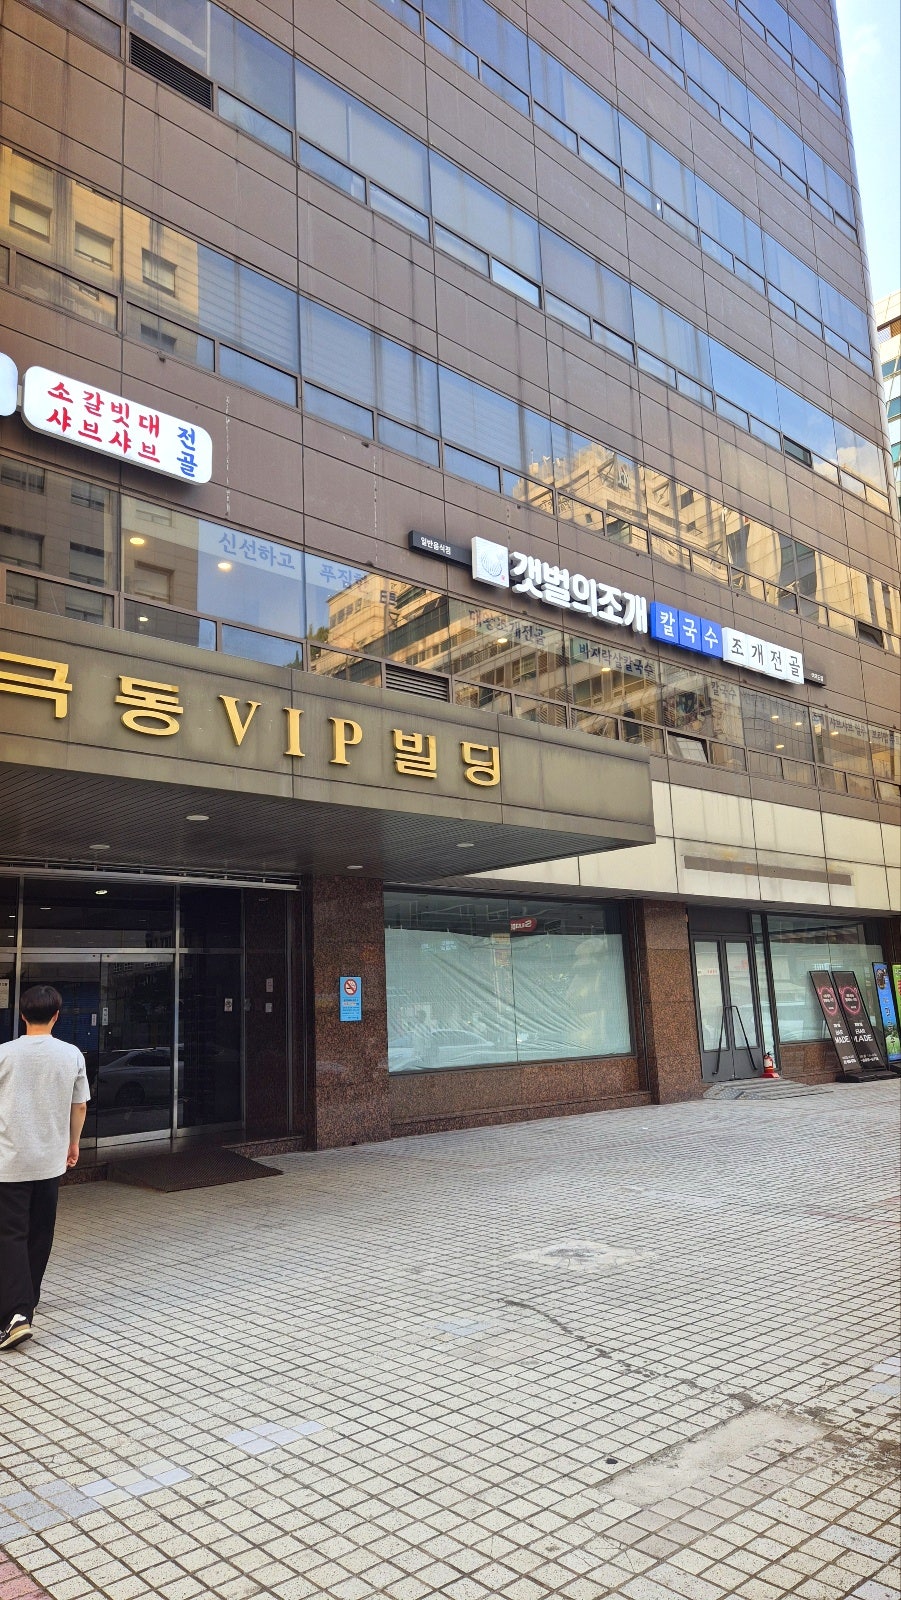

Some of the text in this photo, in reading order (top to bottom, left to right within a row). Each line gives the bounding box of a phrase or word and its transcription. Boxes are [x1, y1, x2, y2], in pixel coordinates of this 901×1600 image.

[48, 381, 160, 438] 소갈빗대
[46, 406, 161, 464] 샤브샤브
[176, 426, 199, 478] 전골
[218, 531, 296, 570] 신선하고
[420, 536, 452, 556] 일반음식점
[509, 551, 649, 634] 갯벌의조개
[659, 610, 719, 649] 칼국수
[731, 637, 801, 678] 조개전골
